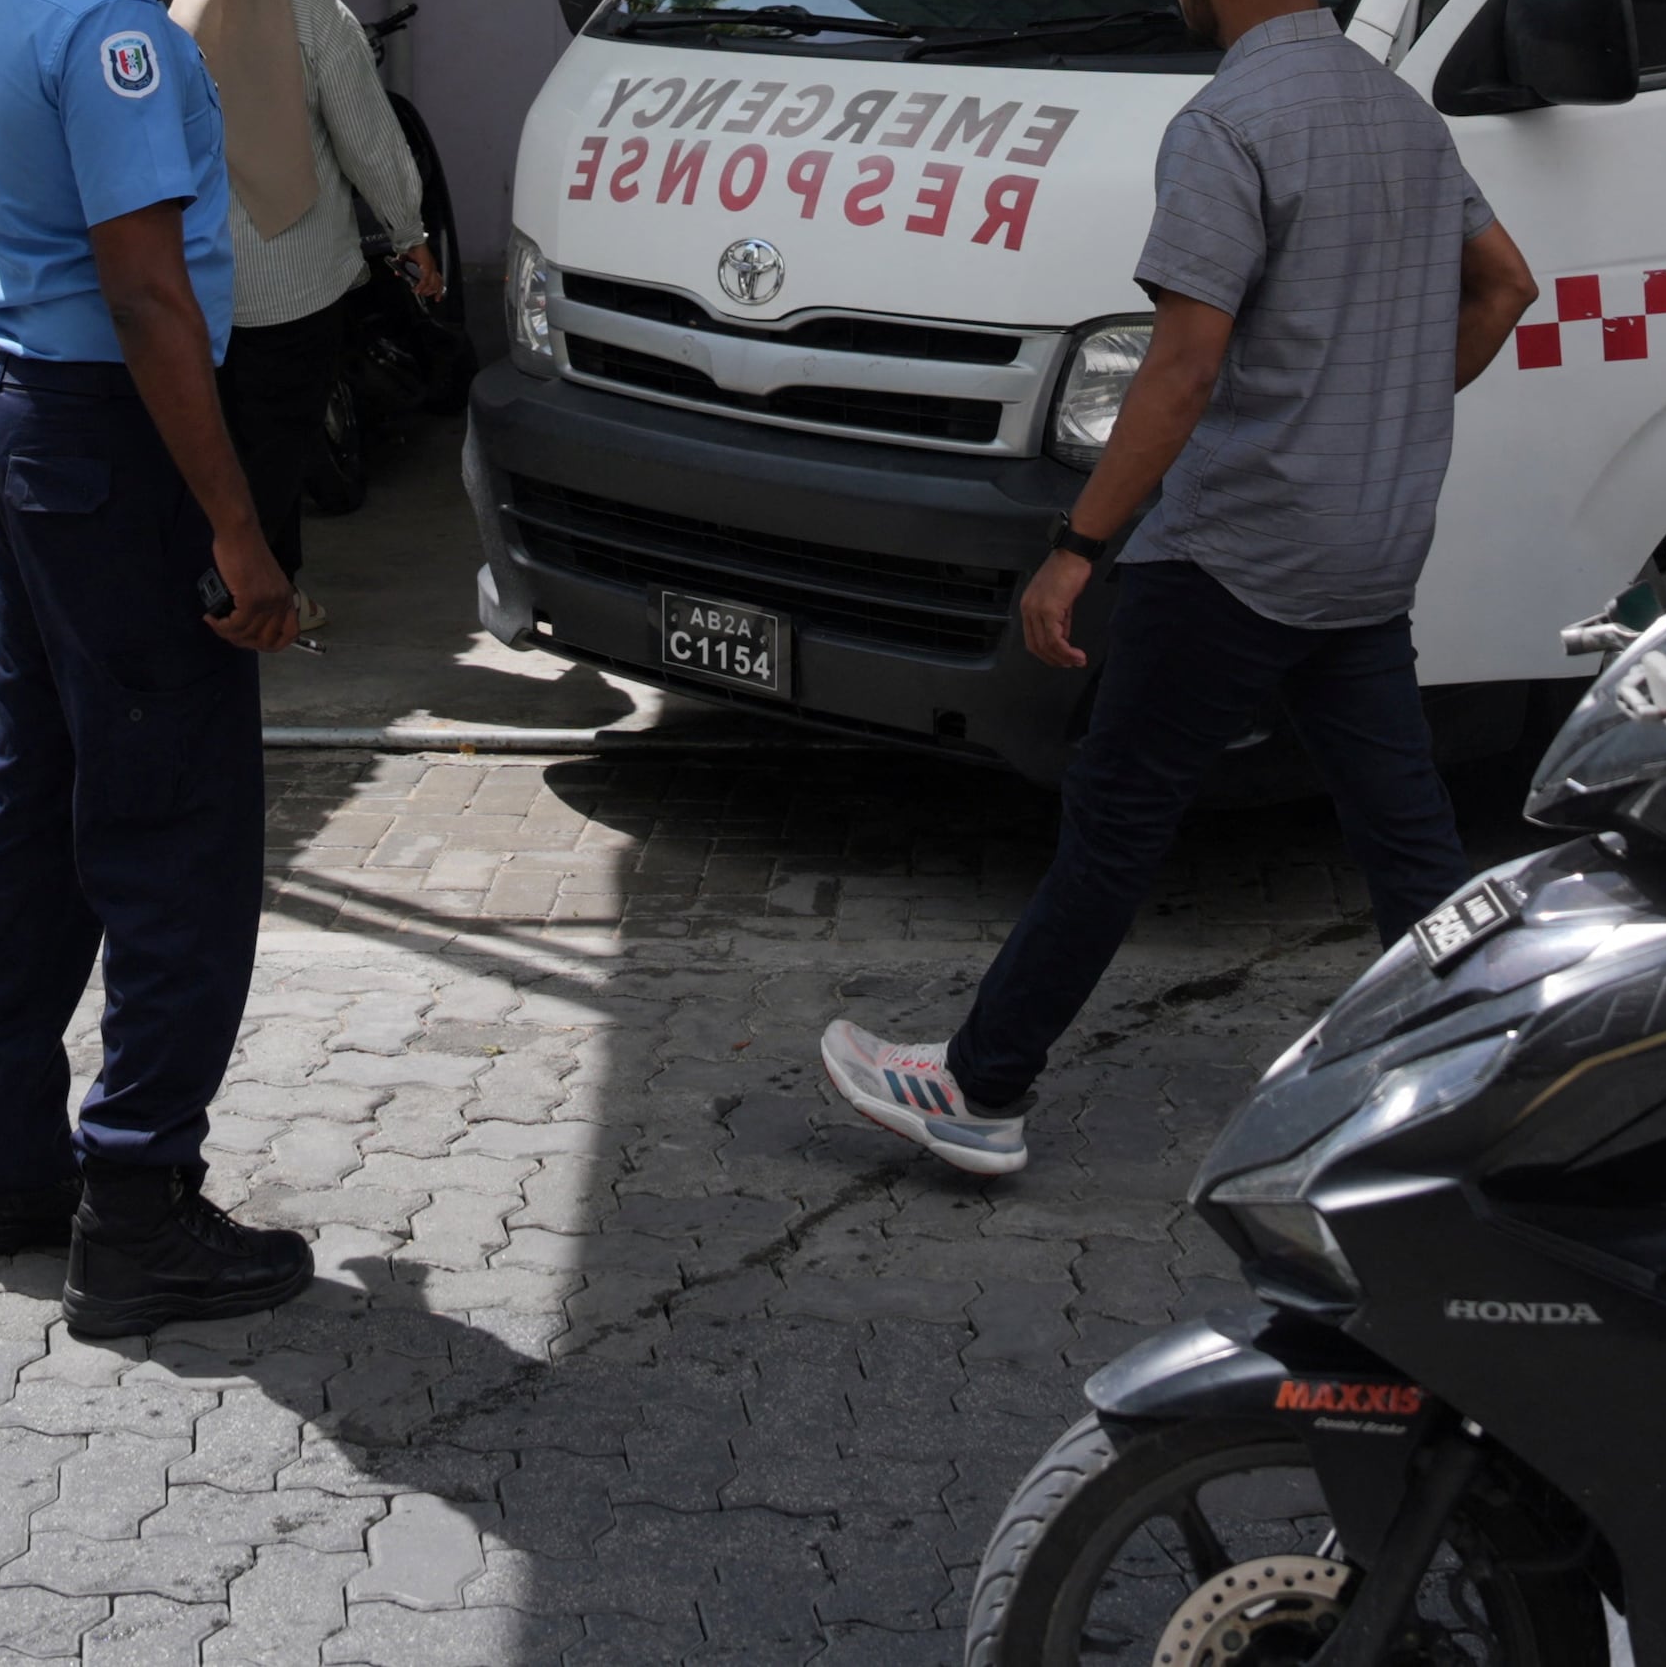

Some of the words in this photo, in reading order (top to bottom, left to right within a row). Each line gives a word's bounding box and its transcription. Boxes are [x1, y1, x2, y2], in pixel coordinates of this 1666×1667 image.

[690, 606, 752, 639] AB2A
[670, 631, 771, 680] C1154
[1444, 1299, 1603, 1325] HONDA
[1274, 1379, 1422, 1415] MAXXIS
